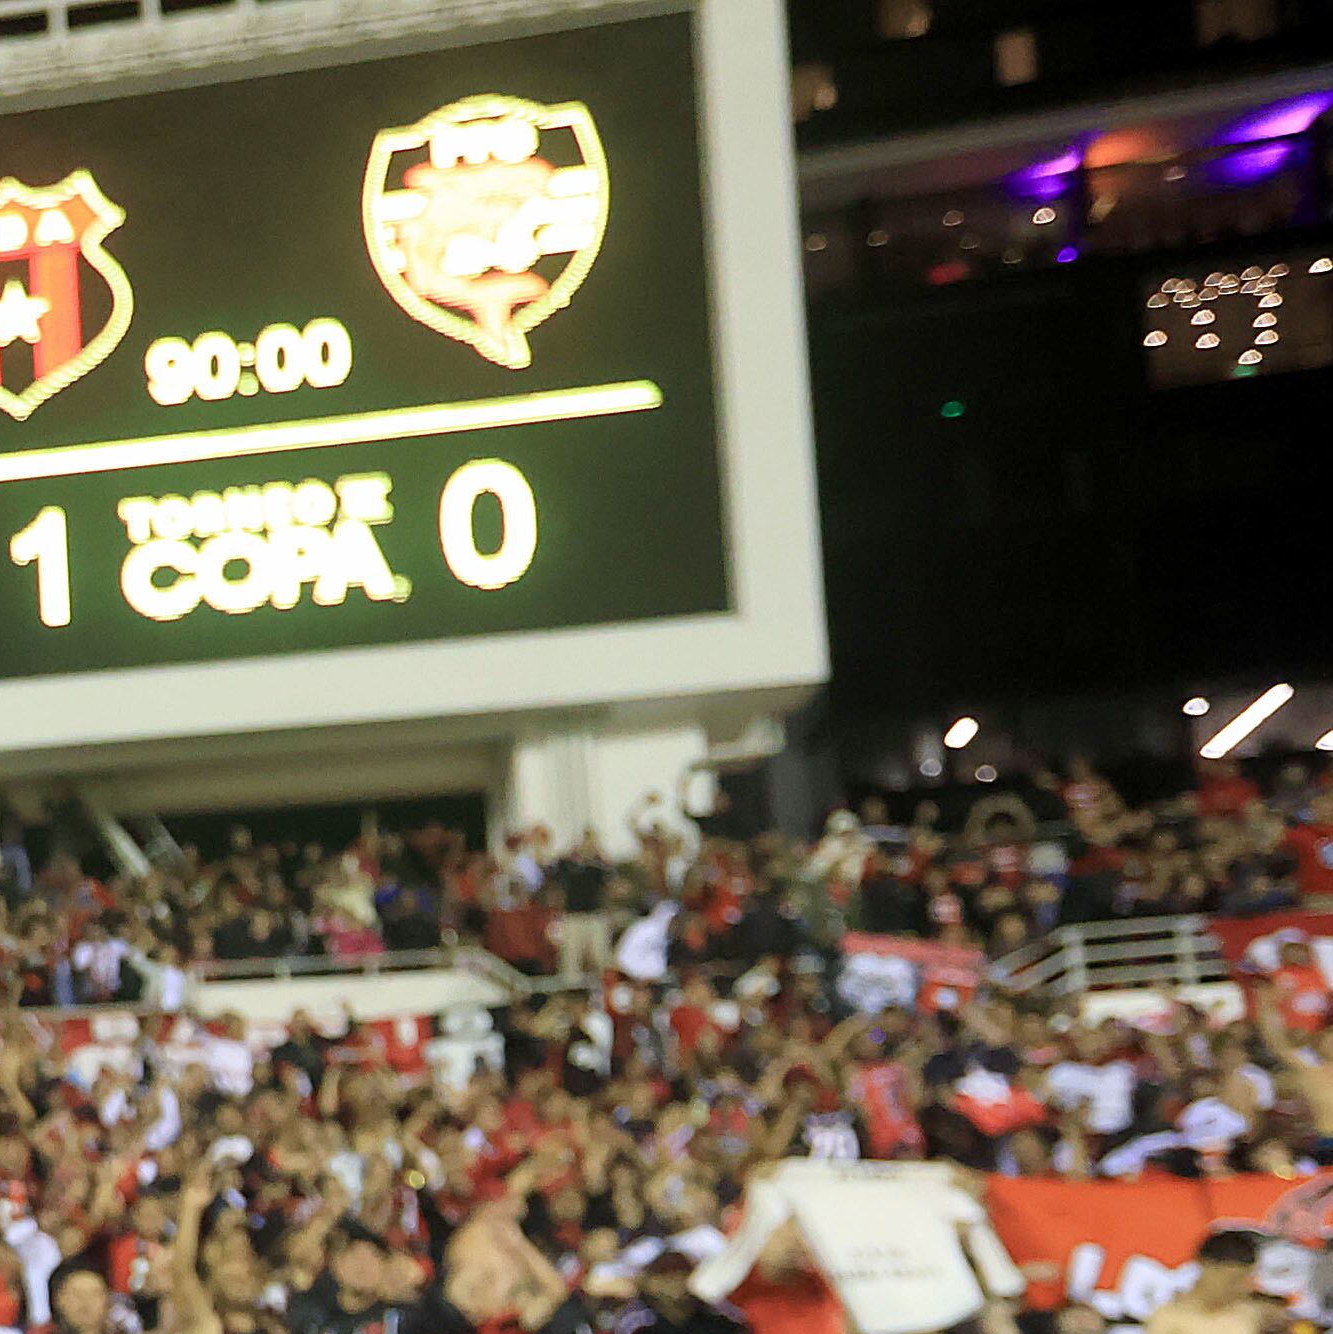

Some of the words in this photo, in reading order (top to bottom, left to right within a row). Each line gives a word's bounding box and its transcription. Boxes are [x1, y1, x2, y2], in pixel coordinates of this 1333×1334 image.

[143, 314, 353, 406] 90:00
[9, 505, 71, 627] 1
[119, 522, 399, 621] COPA
[438, 457, 538, 590] 0
